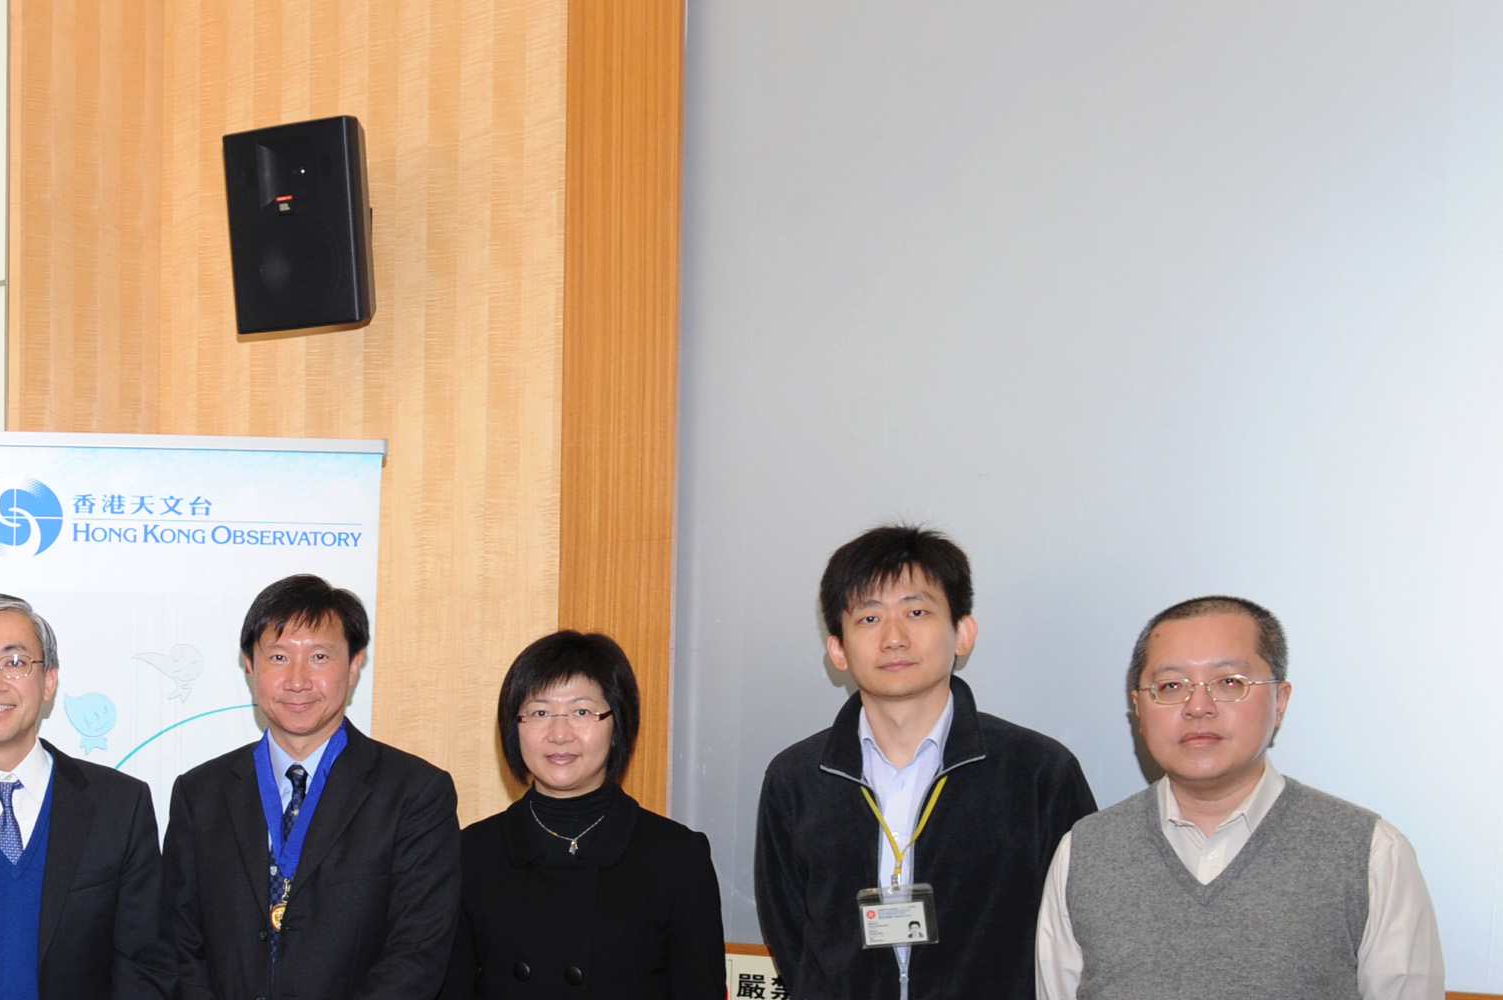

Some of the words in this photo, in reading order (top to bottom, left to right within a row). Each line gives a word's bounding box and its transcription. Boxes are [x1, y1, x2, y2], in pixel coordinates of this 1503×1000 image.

[72, 493, 212, 516] 香港天文台
